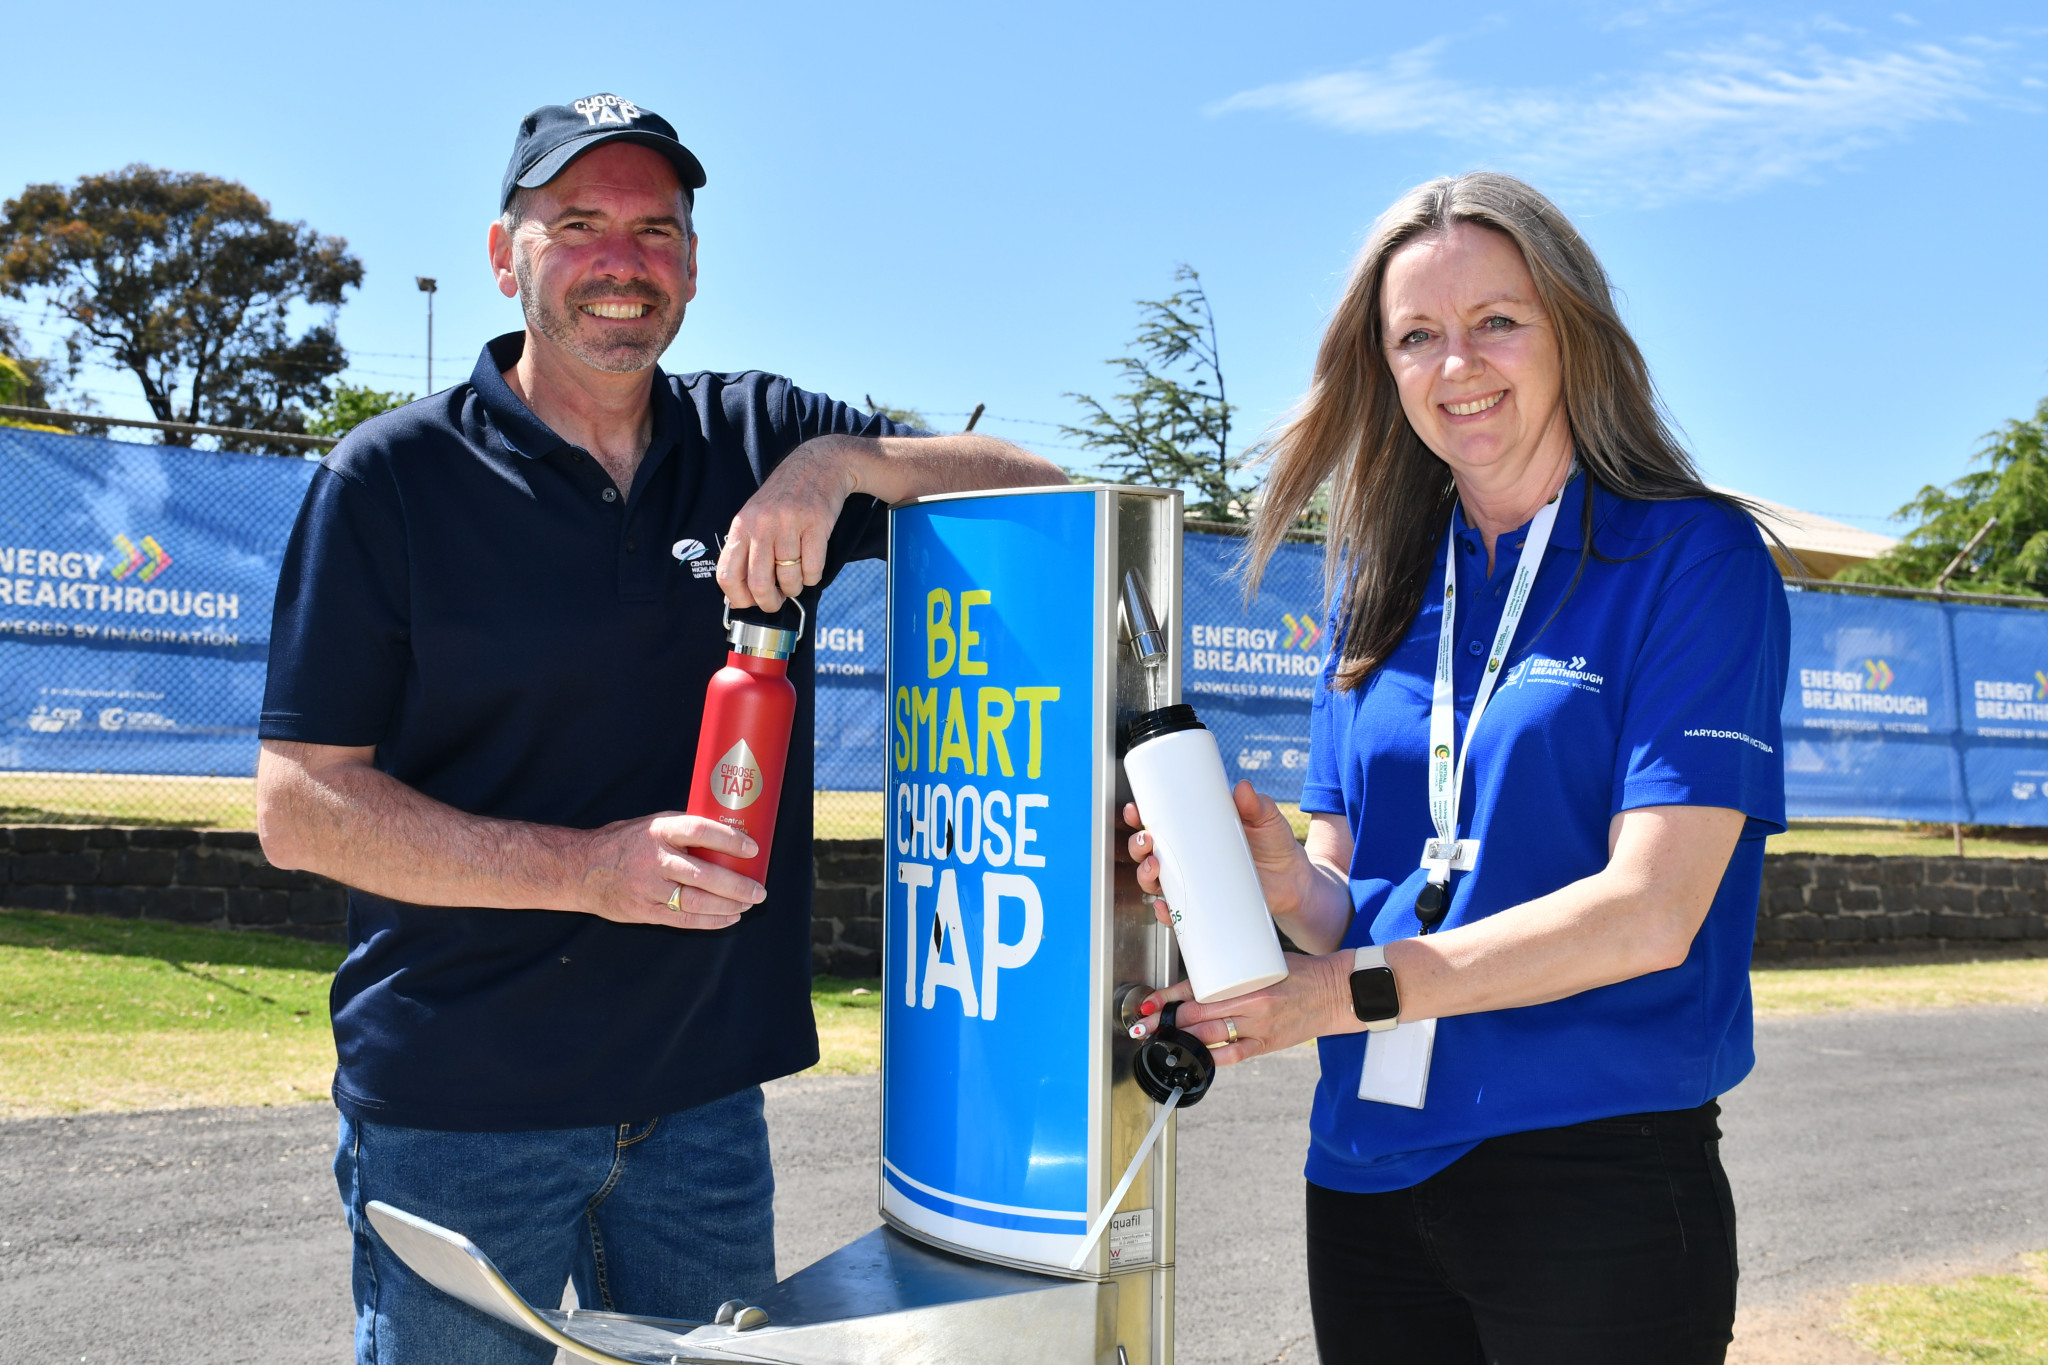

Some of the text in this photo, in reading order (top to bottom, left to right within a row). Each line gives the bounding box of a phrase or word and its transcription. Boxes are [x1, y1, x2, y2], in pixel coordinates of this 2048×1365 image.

[574, 95, 638, 111] CHOOSE
[577, 105, 641, 126] TAP
[0, 547, 104, 580] NERGY
[0, 577, 239, 620] REAKTHROUGH
[73, 623, 99, 638] BY
[104, 625, 239, 648] IMAGINATION
[927, 587, 991, 679] BE
[1192, 625, 1278, 650] ENERGY
[1193, 649, 1320, 677] BREAKTHRO
[1533, 659, 1568, 668] ENERGY
[1530, 667, 1603, 685] BREAKTHROUGH
[1800, 669, 1863, 691] ENERGY
[1193, 681, 1258, 696] POWERED
[1260, 685, 1276, 696] BY
[1572, 682, 1600, 693] VICTORIA
[1975, 680, 2034, 701] ENERGY
[1802, 689, 1928, 715] BREAKTHROUGH
[1976, 701, 2048, 721] BREAKTH
[895, 686, 1061, 779] SMART
[721, 763, 756, 779] CHOOSE
[721, 774, 754, 797] TAP
[719, 815, 745, 826] Central
[897, 782, 1049, 867] CHOOSE
[898, 861, 1044, 1021] TAP
